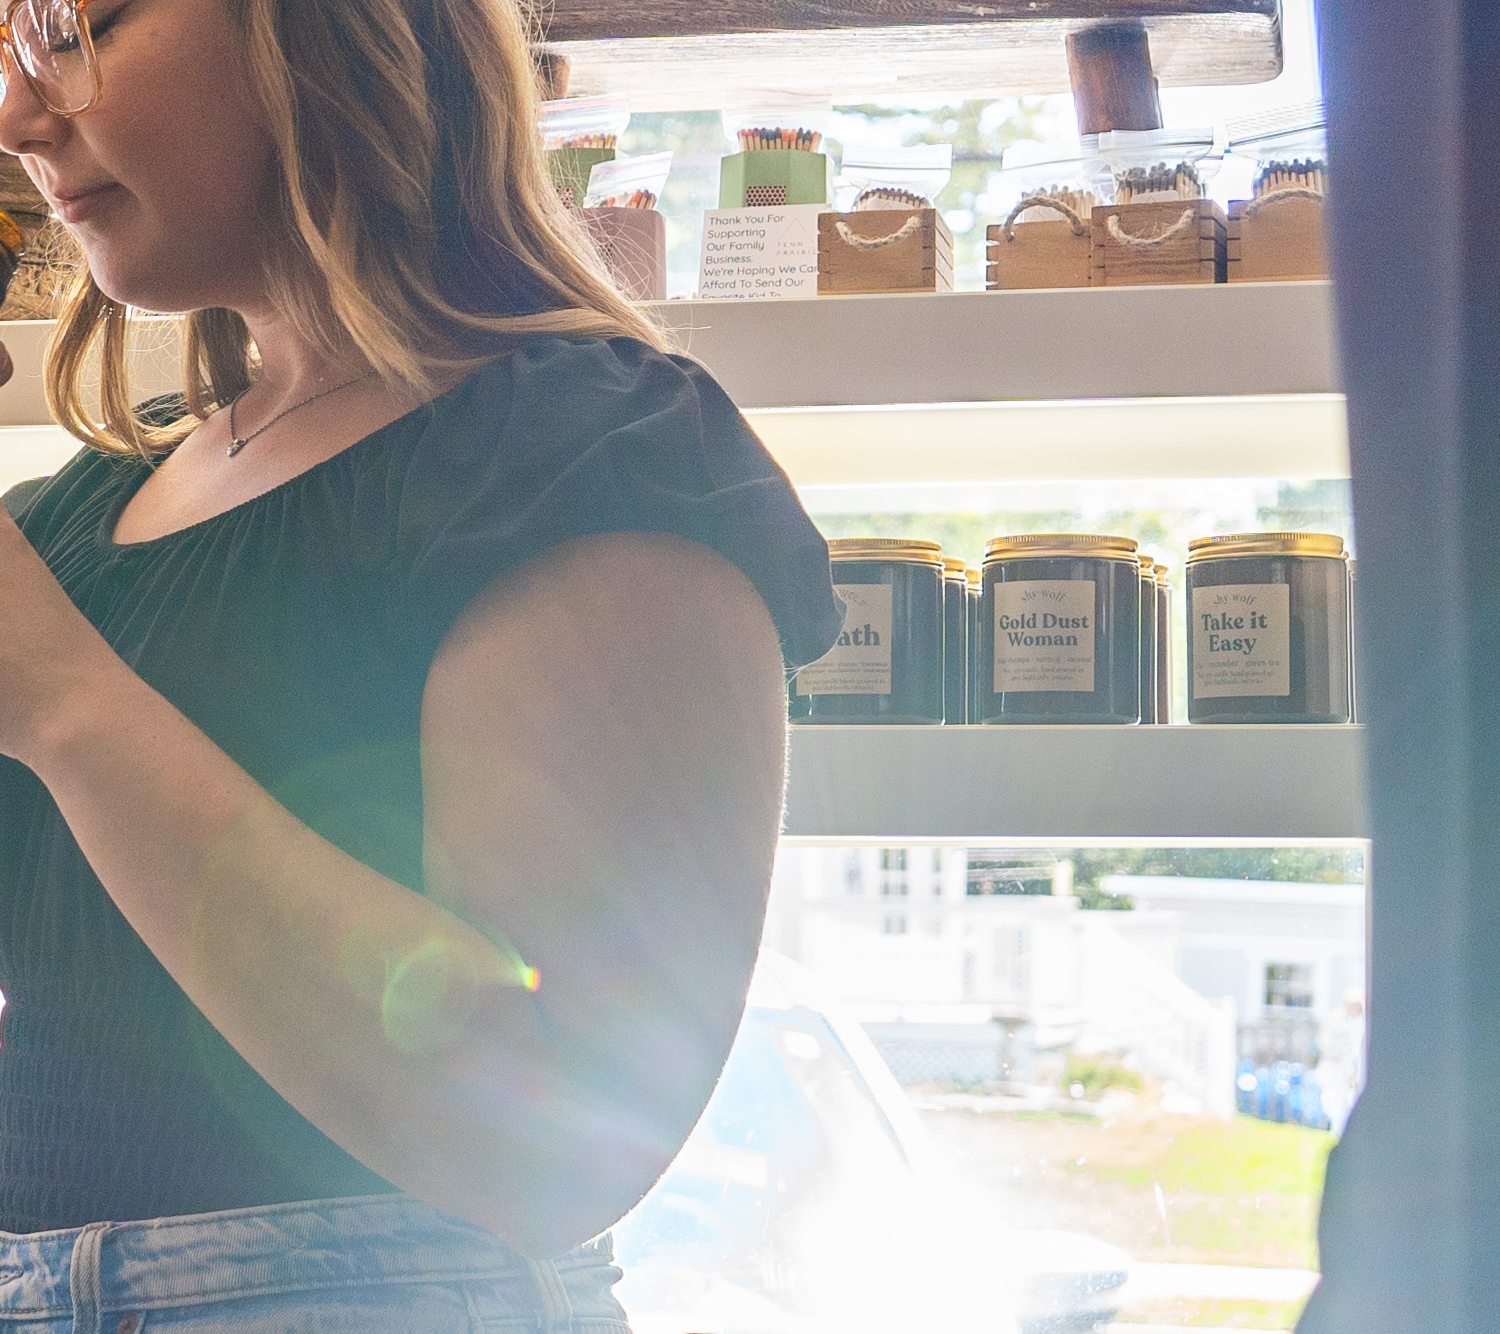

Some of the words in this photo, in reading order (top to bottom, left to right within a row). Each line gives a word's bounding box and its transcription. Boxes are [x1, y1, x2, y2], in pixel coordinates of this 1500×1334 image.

[710, 216, 741, 225] Thank
[745, 215, 764, 224] You
[767, 214, 785, 223] For
[707, 229, 766, 239] Supporting
[706, 242, 726, 252] Our
[729, 241, 765, 252] Family
[705, 255, 754, 265] Business.
[703, 267, 734, 276] We're
[737, 266, 776, 277] Hoping
[779, 266, 796, 274] We
[702, 280, 736, 289] Afford
[740, 279, 752, 288] To
[755, 279, 782, 288] Send
[785, 278, 805, 287] Our
[1000, 613, 1037, 630] Gold
[1042, 613, 1090, 629] Dust
[1201, 612, 1245, 631] Take
[1250, 611, 1268, 629] it
[1007, 632, 1079, 647] Woman
[1209, 634, 1257, 655] Easy
